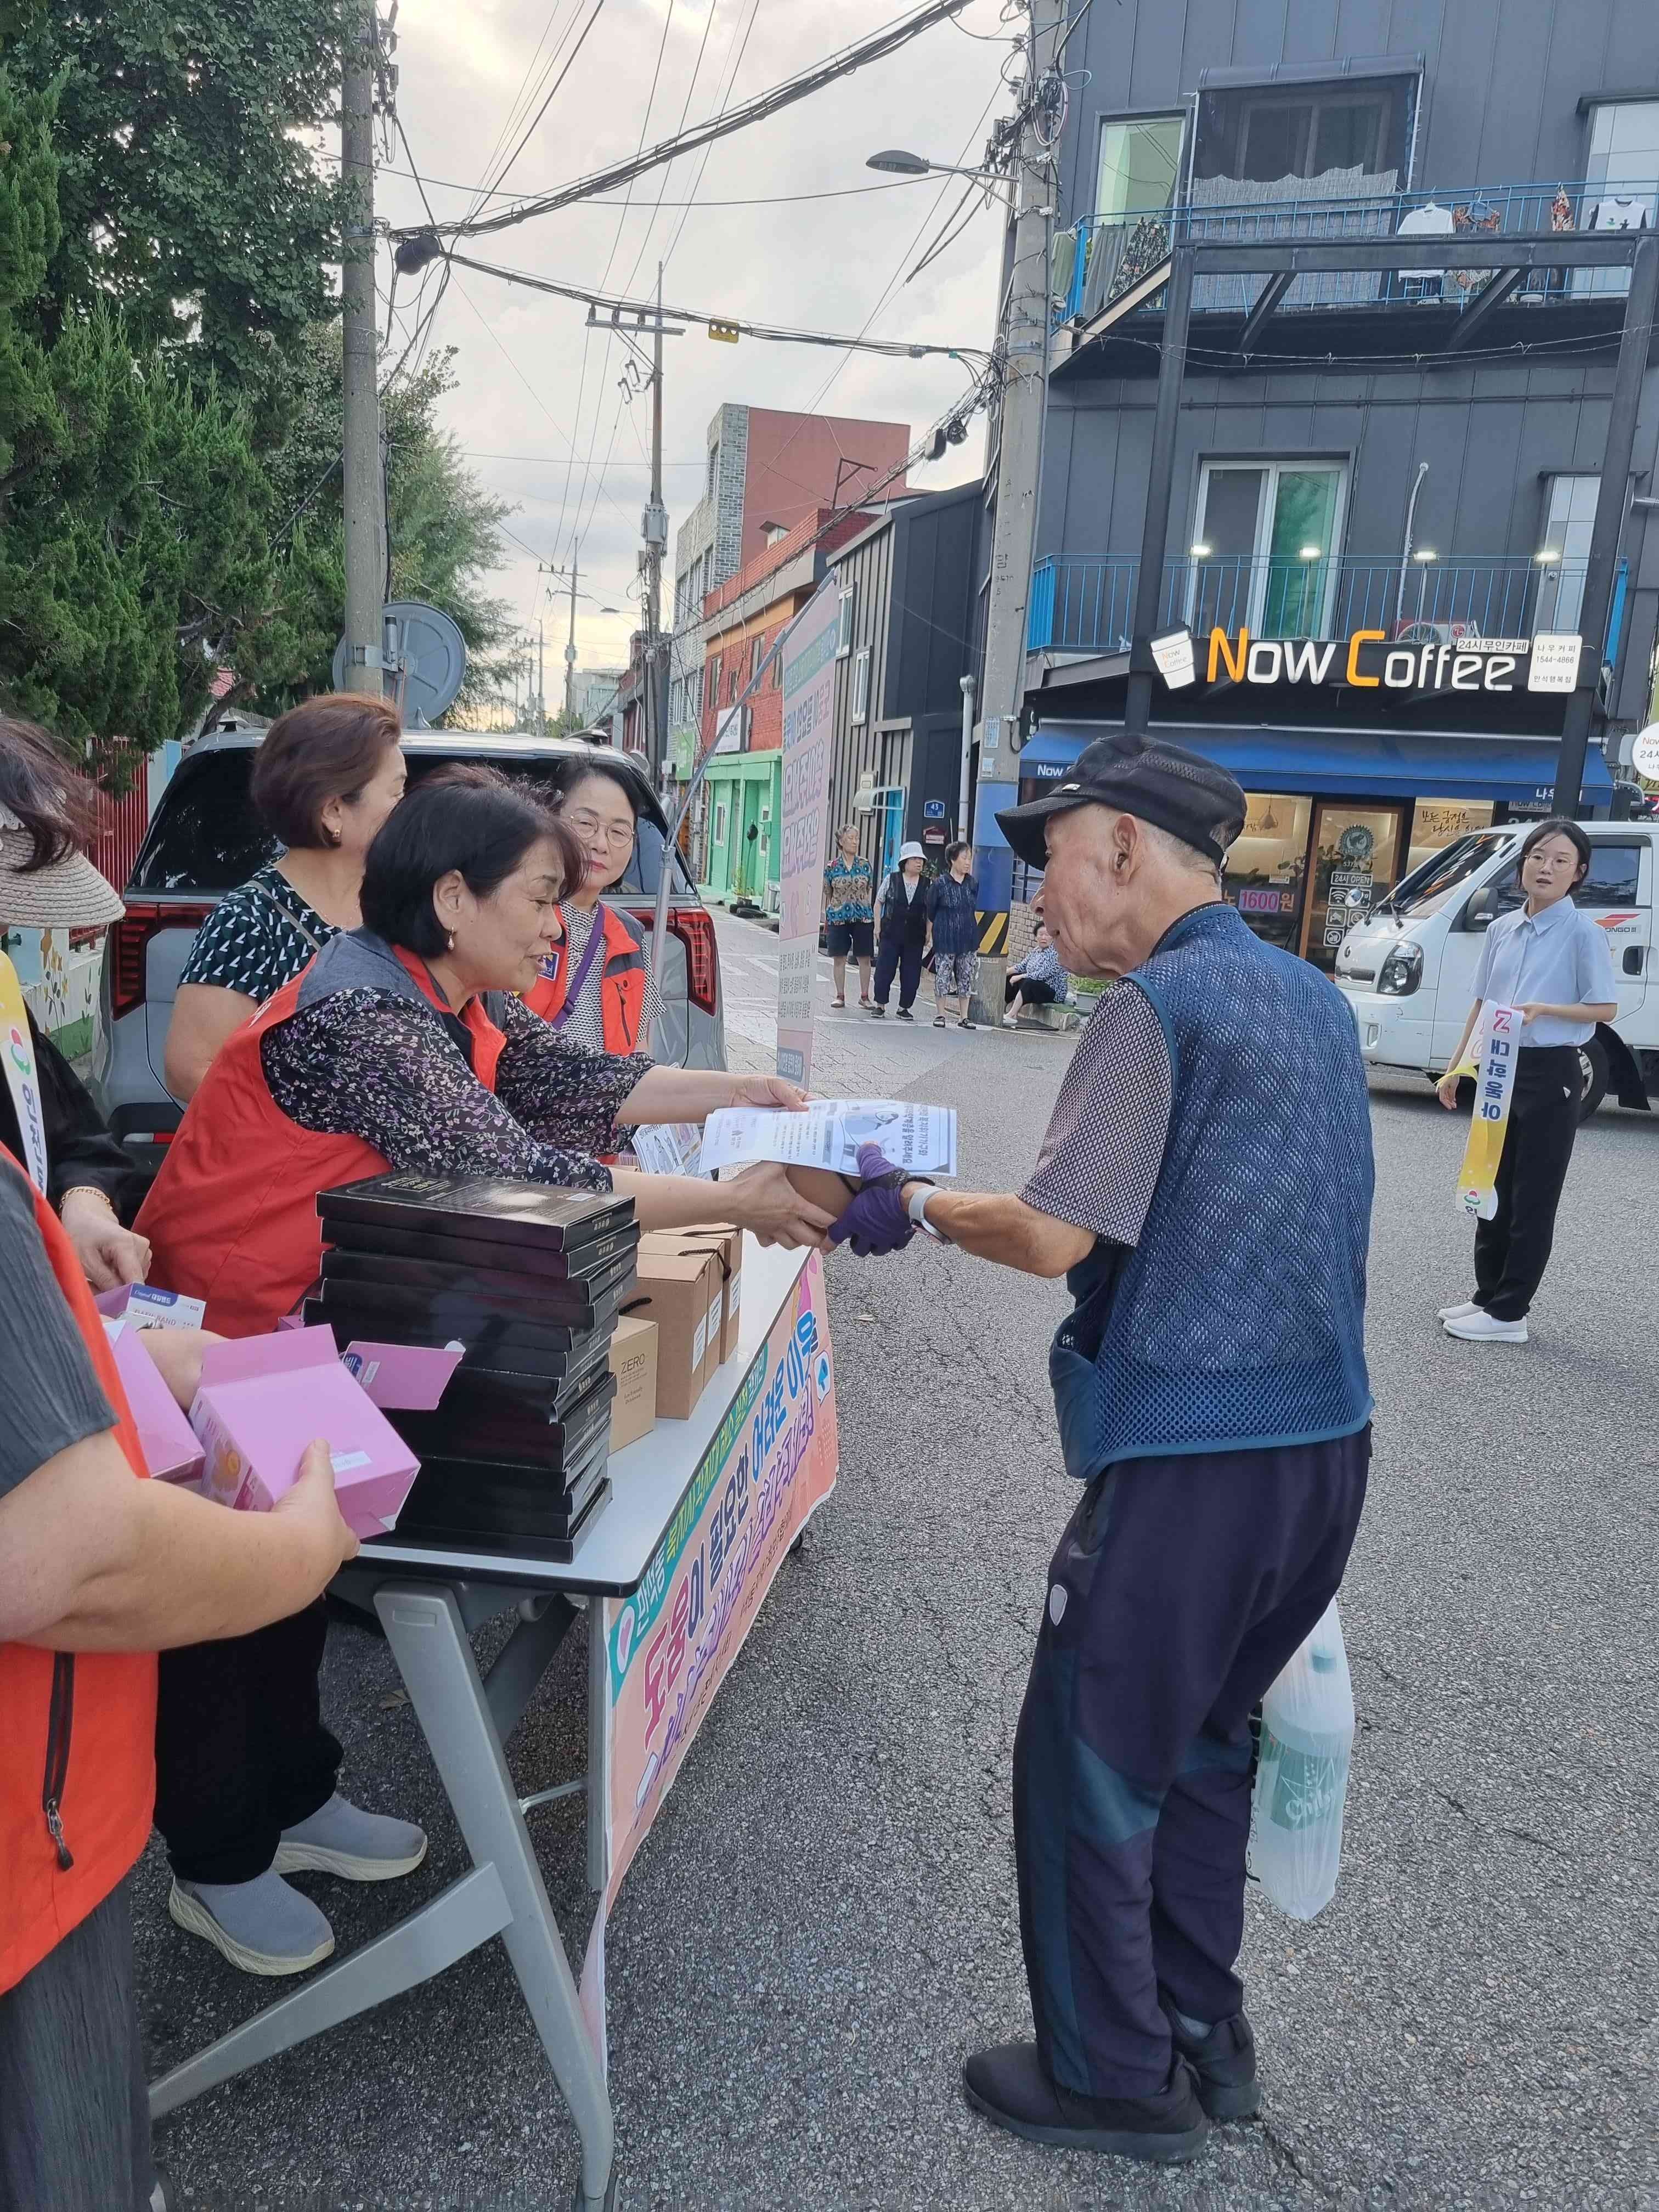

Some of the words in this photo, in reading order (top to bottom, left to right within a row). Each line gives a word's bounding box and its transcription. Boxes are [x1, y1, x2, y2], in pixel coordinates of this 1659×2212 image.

[1458, 640, 1527, 652] 24시무인카페
[1538, 645, 1576, 653] 나우커피
[1346, 630, 1517, 691] Coffee
[1037, 764, 1063, 776] Now
[930, 803, 939, 811] 43
[1334, 874, 1348, 884] 24시
[1350, 876, 1370, 884] OPEN
[1481, 1039, 1510, 1121] 아동학대
[901, 1135, 915, 1164] 알려주세요
[621, 1353, 645, 1374] ZERO
[644, 1541, 705, 1752] 도움이
[710, 1442, 749, 1593] 필요한
[752, 1357, 787, 1483] 어려운
[637, 1544, 665, 1638] 만석동
